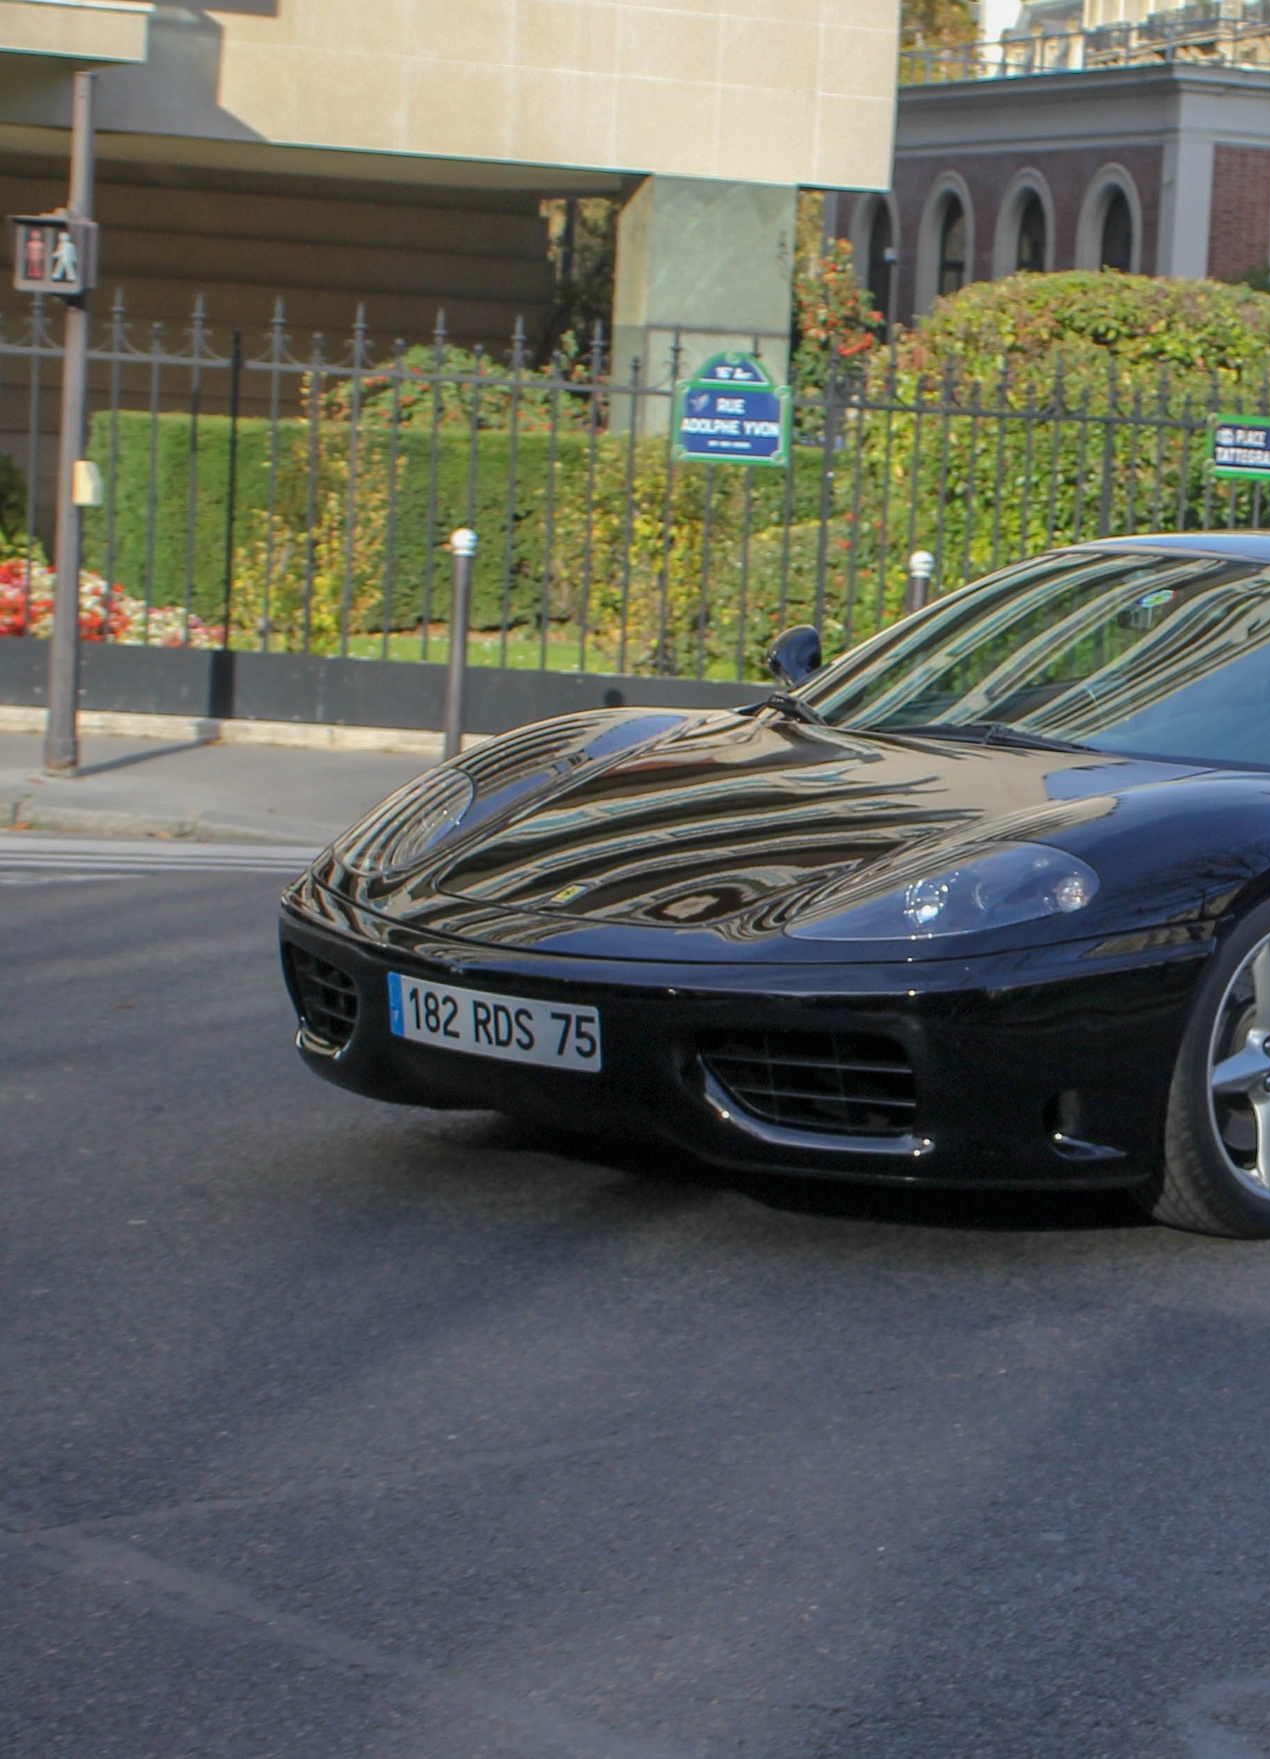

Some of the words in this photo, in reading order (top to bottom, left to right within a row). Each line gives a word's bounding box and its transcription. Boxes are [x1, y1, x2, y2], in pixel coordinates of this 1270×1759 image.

[716, 398, 746, 415] RUE
[680, 418, 741, 436] ADOLPHE
[743, 421, 780, 438] YVON
[1235, 429, 1267, 448] PLACE
[409, 987, 460, 1039] 182
[472, 1000, 535, 1051] RDS
[551, 1012, 597, 1058] 75
